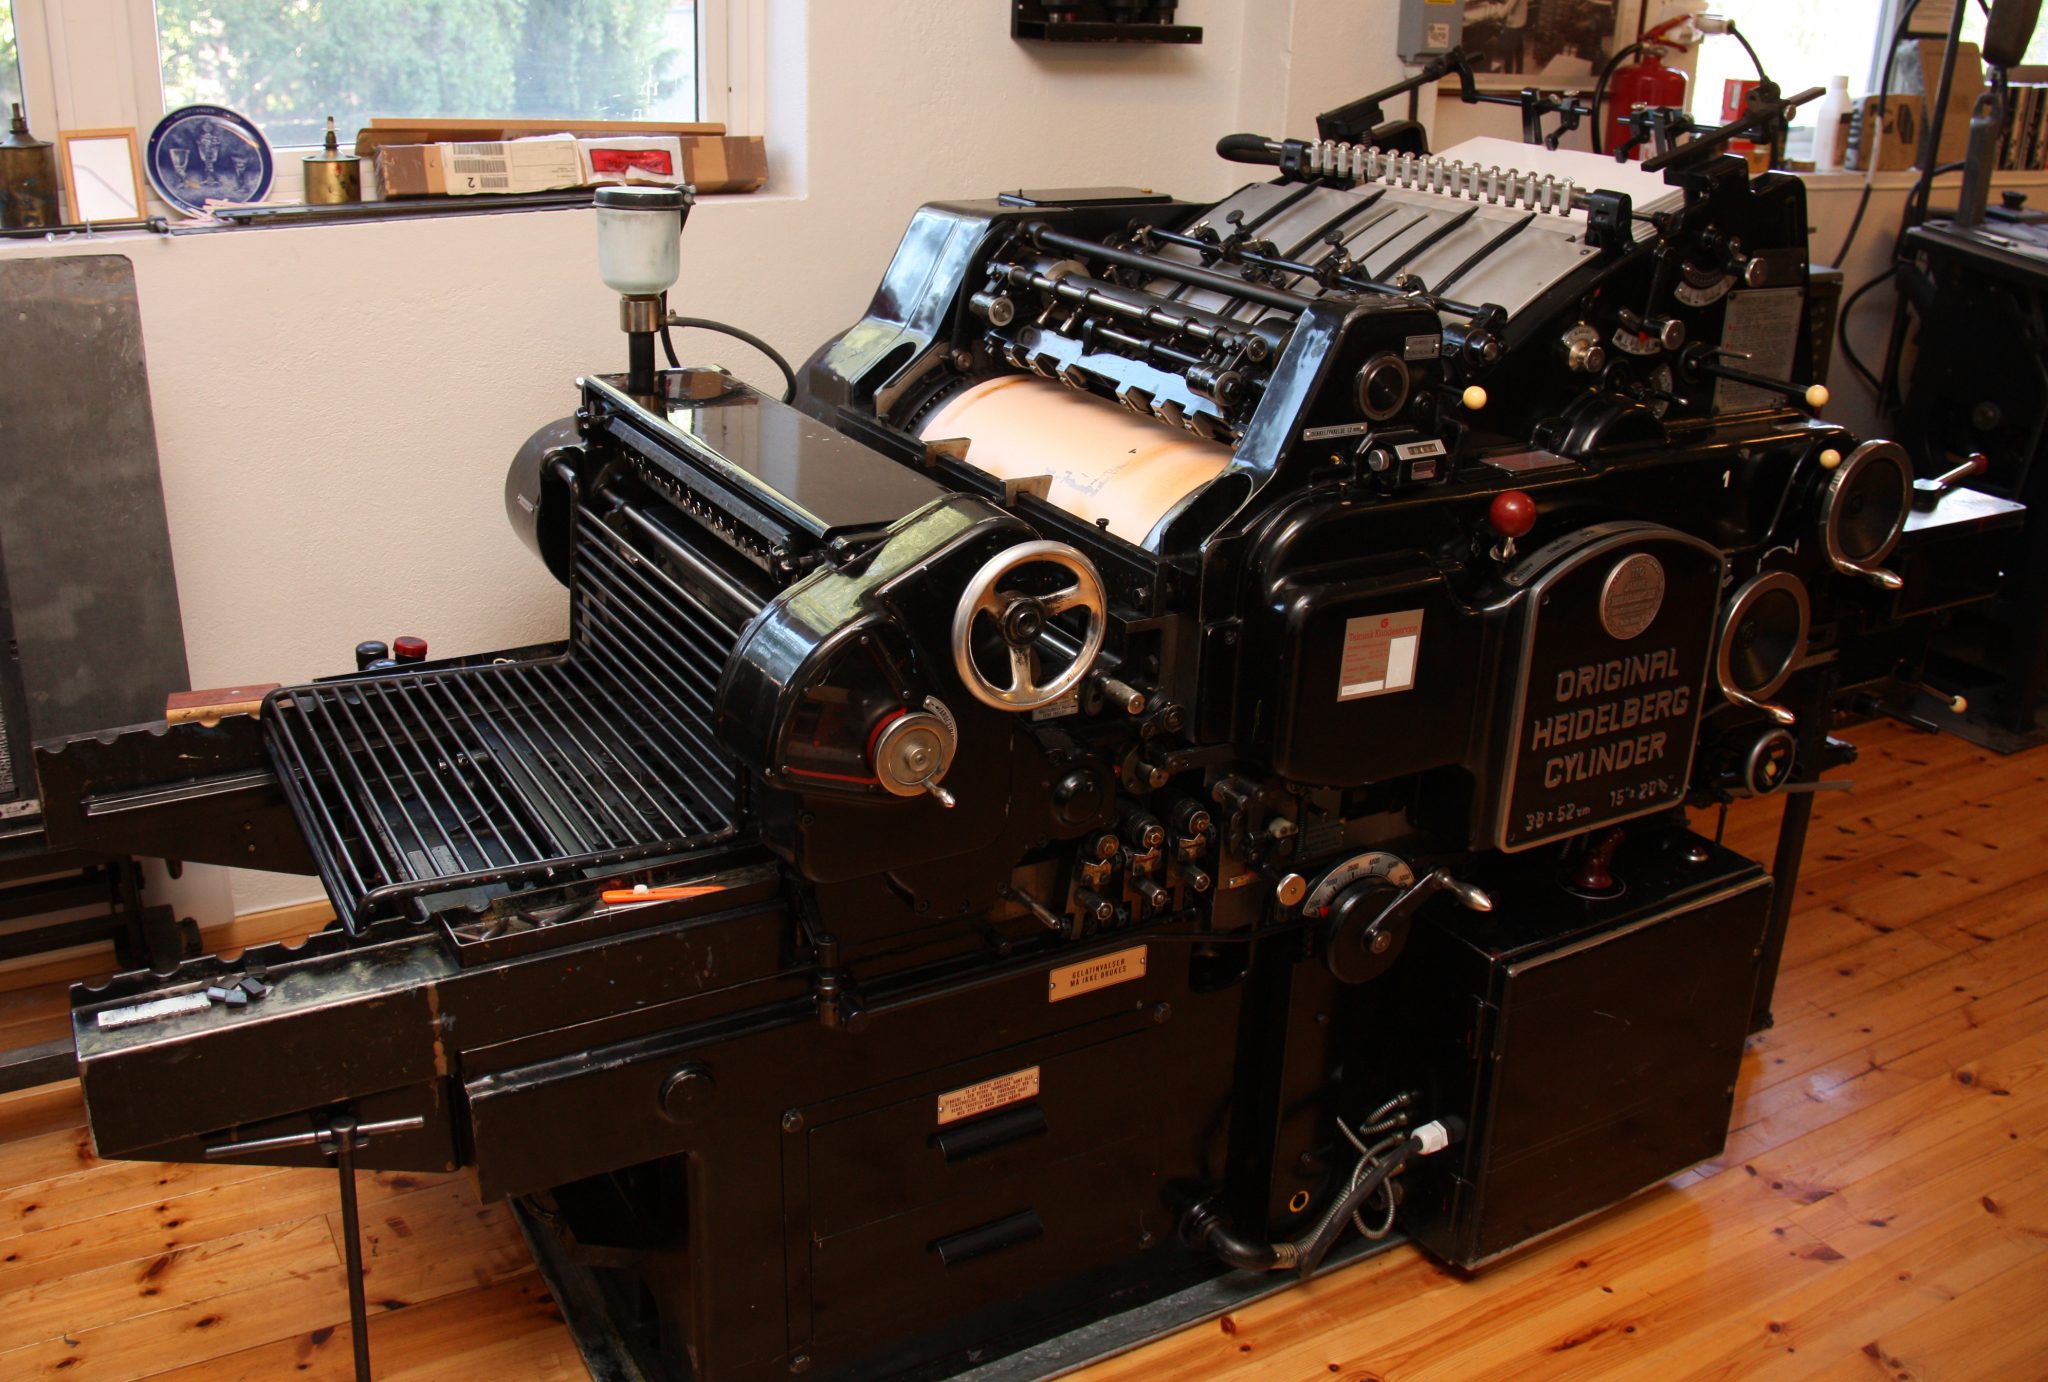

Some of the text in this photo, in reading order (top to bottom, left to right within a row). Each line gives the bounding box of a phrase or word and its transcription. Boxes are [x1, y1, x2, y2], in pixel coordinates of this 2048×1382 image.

[467, 177, 475, 188] 2
[1722, 470, 1731, 488] 1
[1556, 648, 1680, 703] ORIGINAL
[1532, 686, 1691, 751] HEIDELBERG
[1544, 731, 1668, 789] CYLINDER
[1525, 811, 1546, 832] 38
[1557, 803, 1576, 823] 52
[1369, 856, 1381, 866] 4000
[1072, 958, 1126, 978] GELATINVALSER
[1082, 974, 1098, 984] IKKE
[1100, 965, 1127, 979] BRUKES
